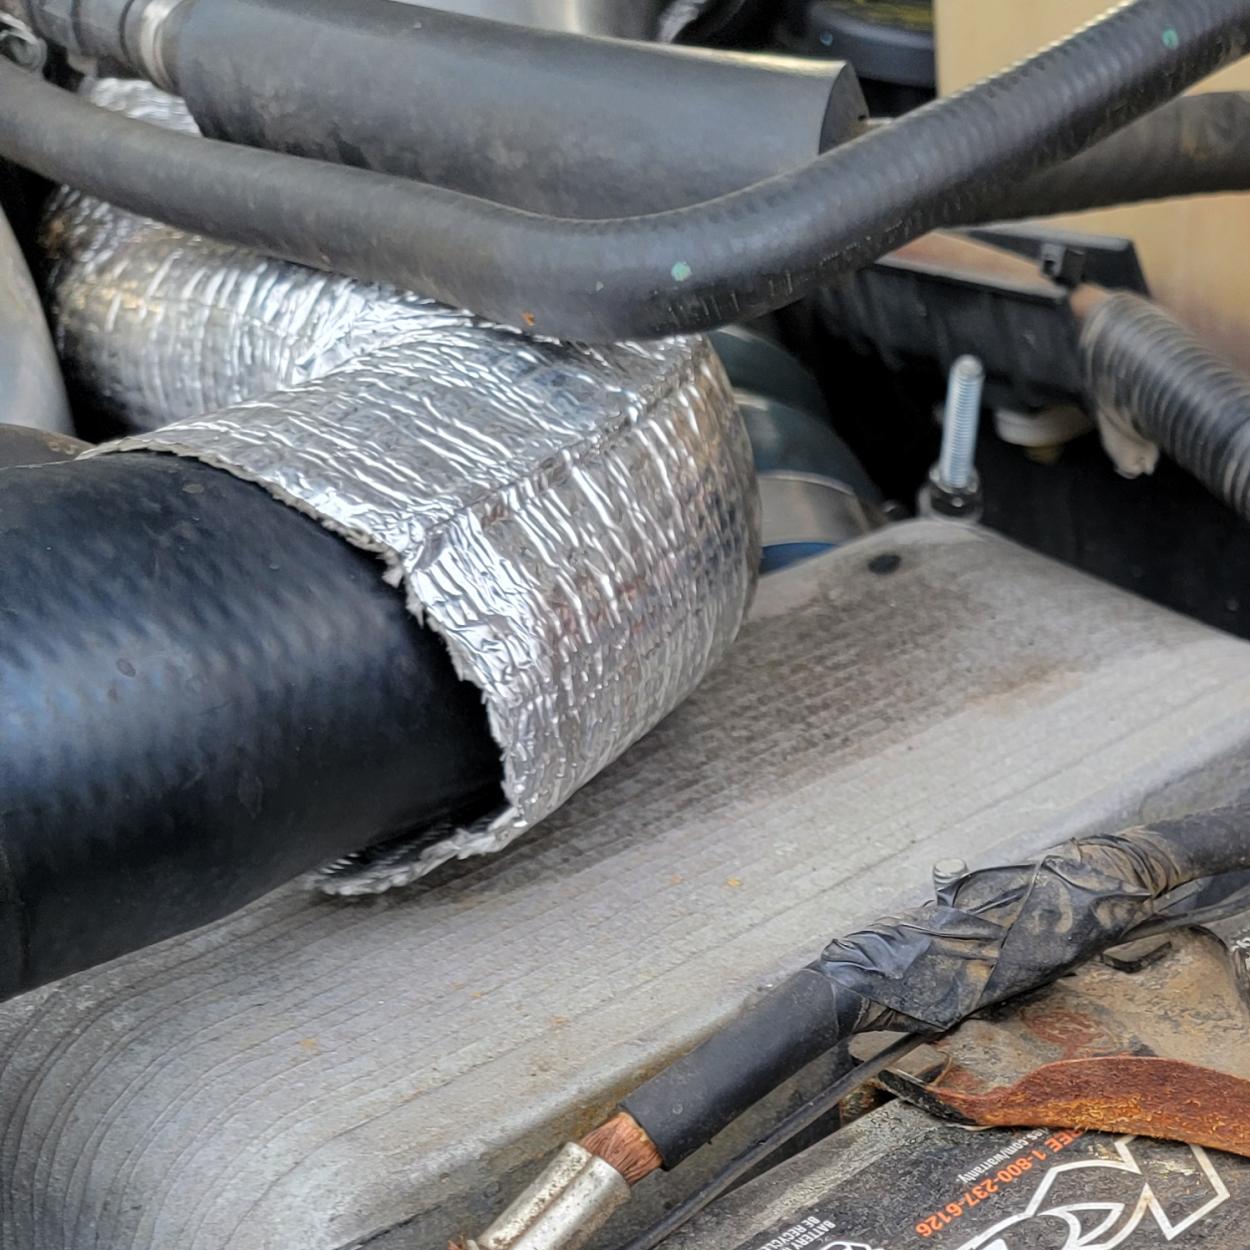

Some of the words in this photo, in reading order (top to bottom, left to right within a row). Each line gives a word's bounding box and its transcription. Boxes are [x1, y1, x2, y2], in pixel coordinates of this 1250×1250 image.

[956, 1126, 1048, 1183] ies.com/warranty.
[913, 1148, 1047, 1238] 1-800-237-6126
[790, 1219, 835, 1250] BATTERY
[800, 1215, 820, 1228] BE
